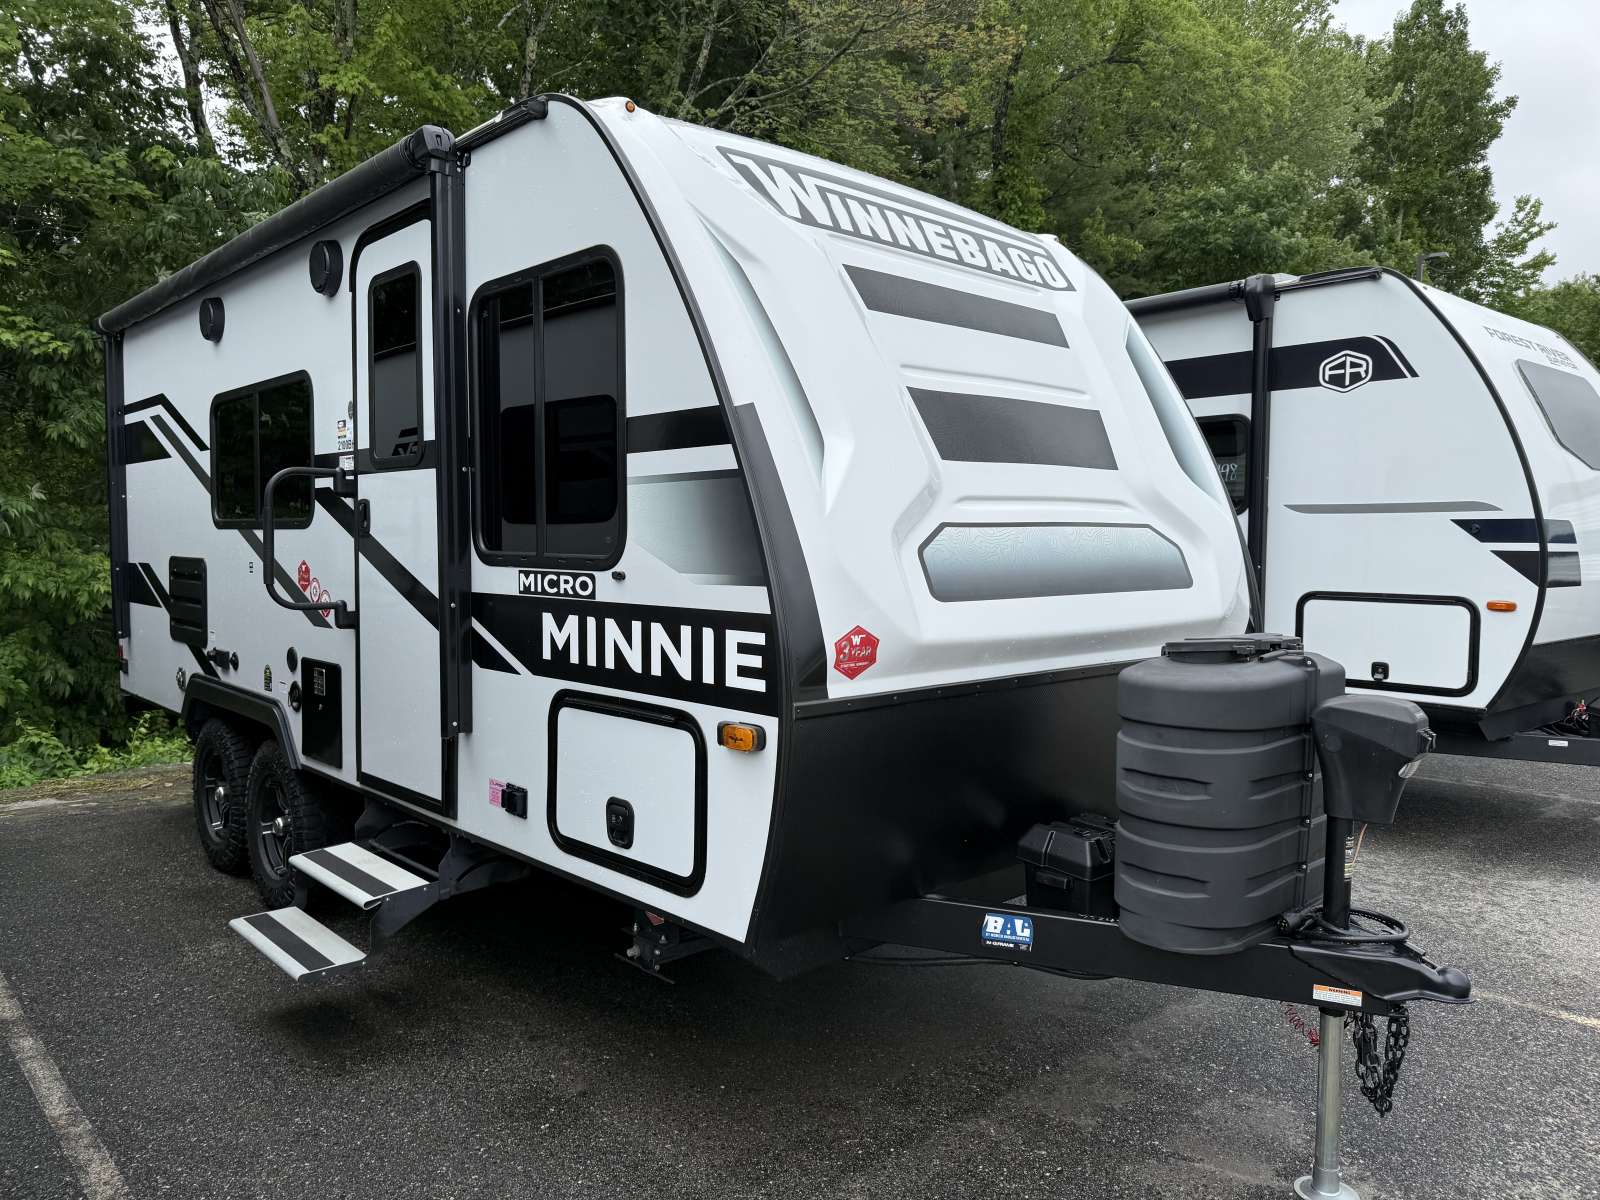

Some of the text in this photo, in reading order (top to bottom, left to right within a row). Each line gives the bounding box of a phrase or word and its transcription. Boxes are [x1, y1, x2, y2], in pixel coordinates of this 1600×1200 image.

[728, 153, 1067, 289] WINNEBAGO
[1483, 325, 1537, 352] FOREST
[518, 573, 594, 597] MICRO
[541, 611, 767, 693] MINNIE
[985, 916, 1031, 937] BAL
